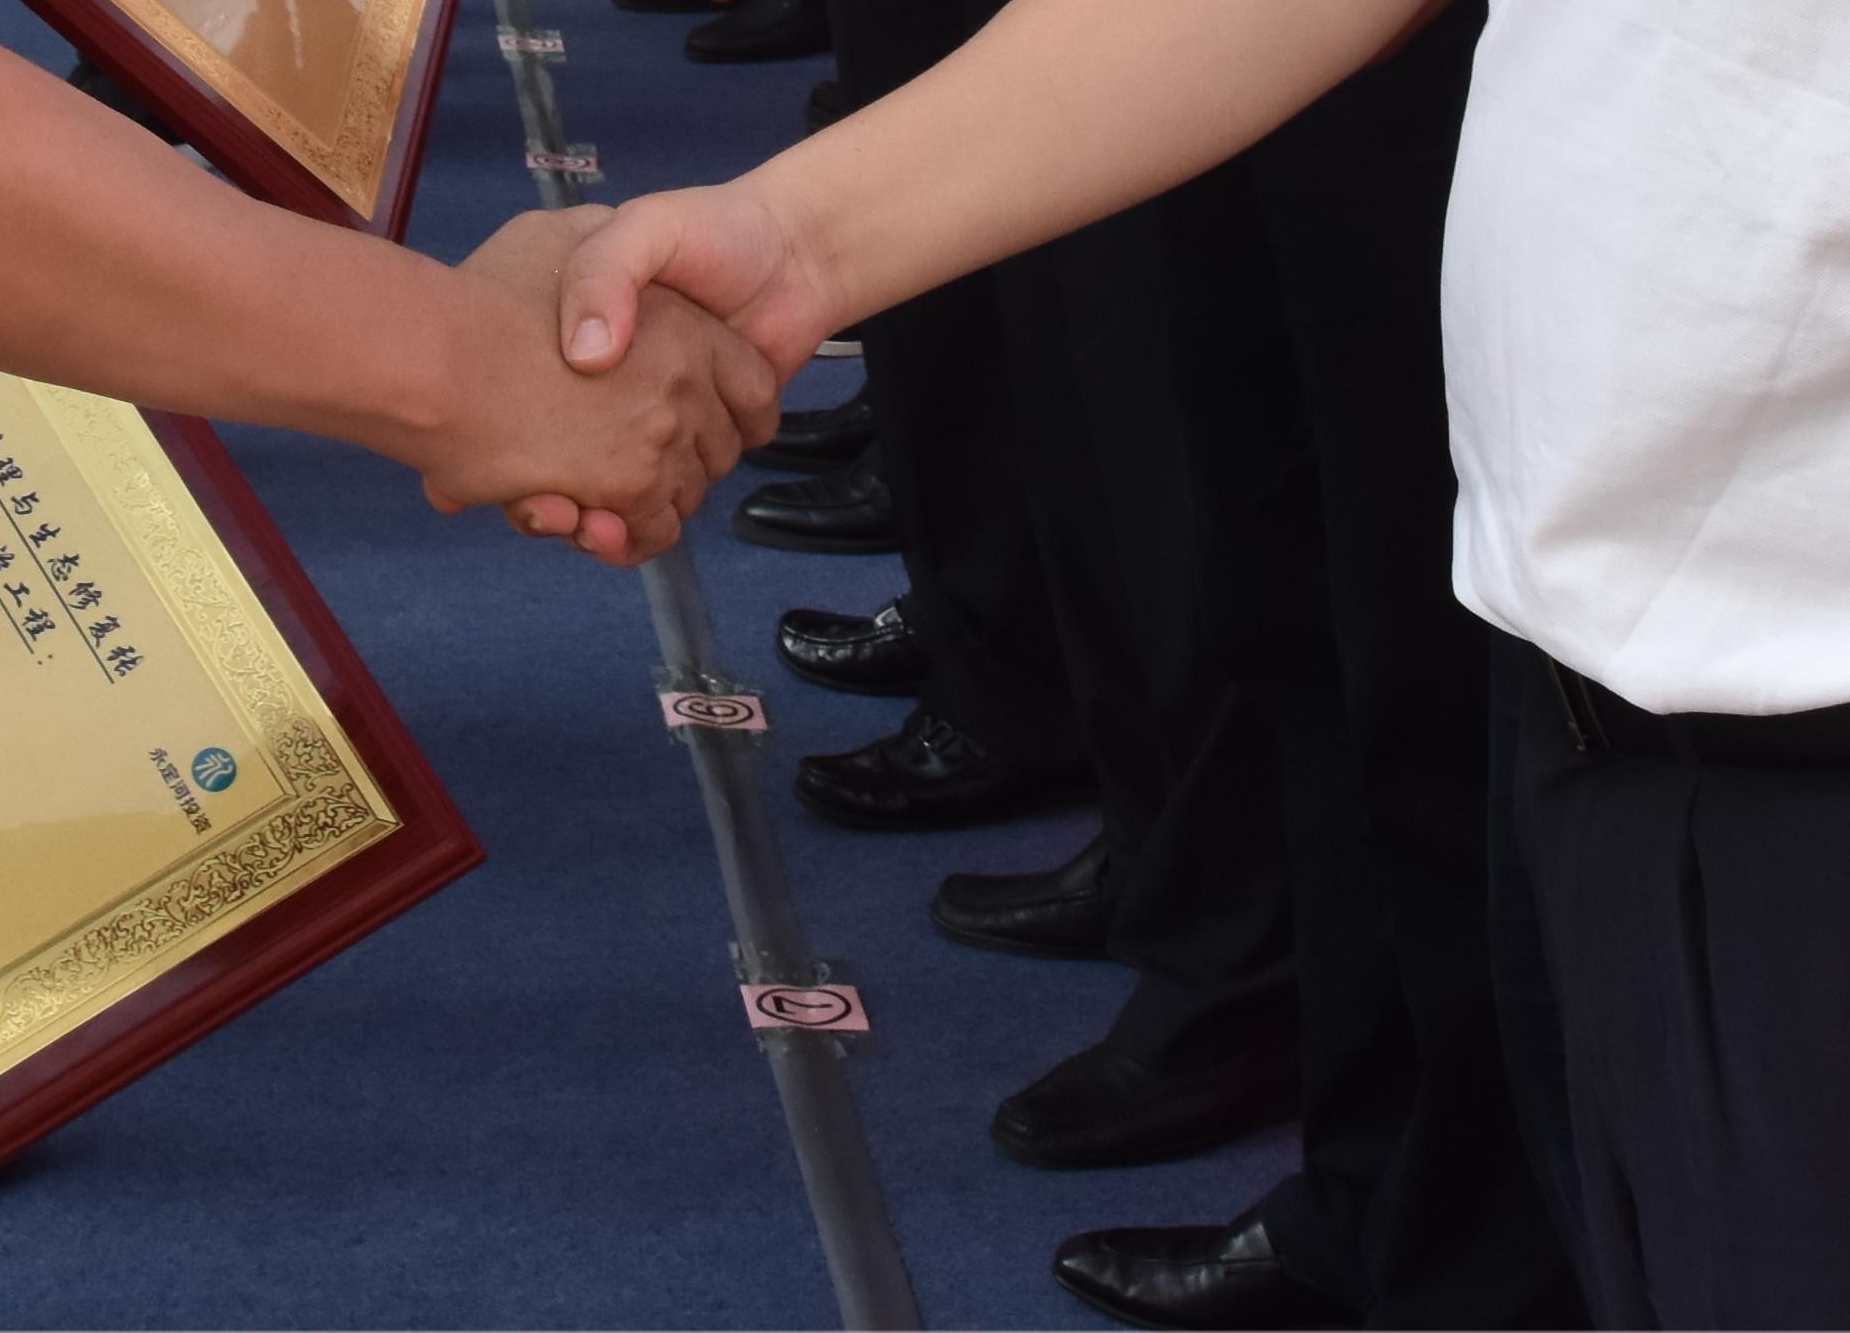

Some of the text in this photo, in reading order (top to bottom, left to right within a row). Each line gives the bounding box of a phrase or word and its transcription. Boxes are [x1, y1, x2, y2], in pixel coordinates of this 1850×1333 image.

[148, 747, 212, 836] 永定河投资
